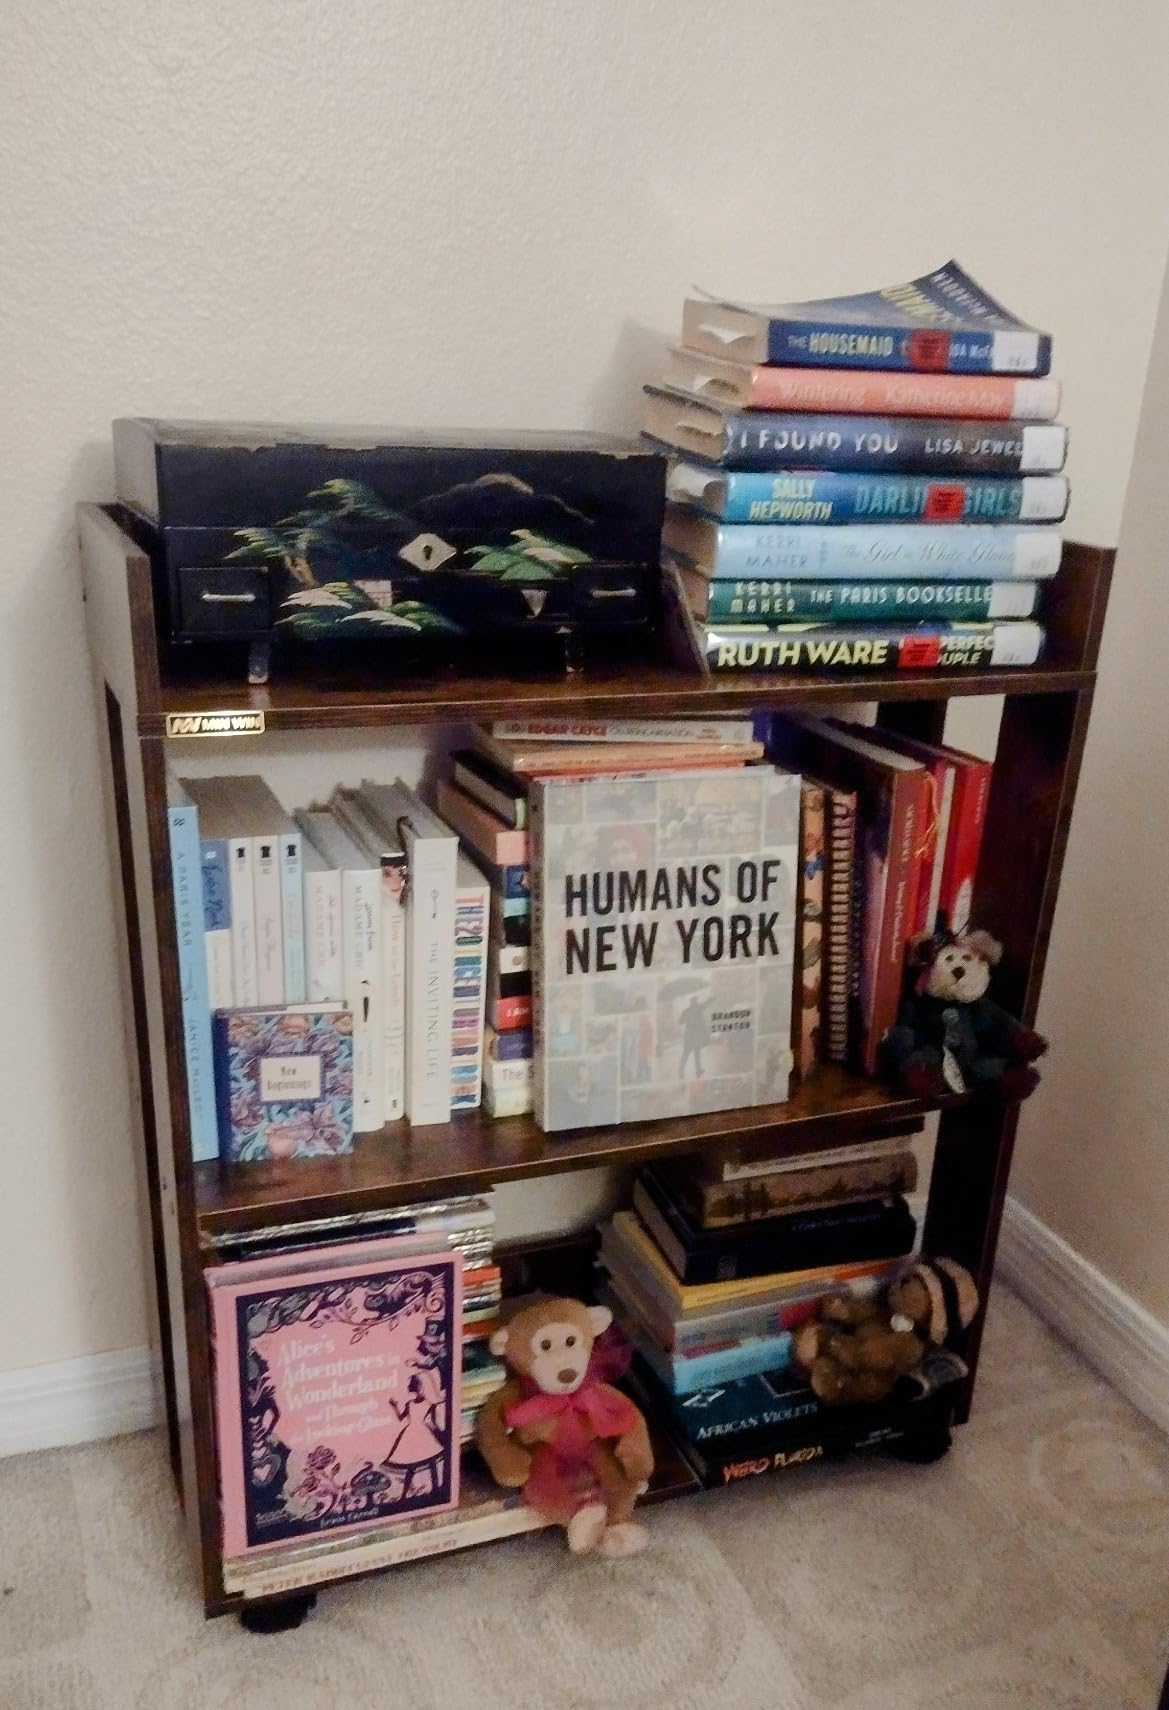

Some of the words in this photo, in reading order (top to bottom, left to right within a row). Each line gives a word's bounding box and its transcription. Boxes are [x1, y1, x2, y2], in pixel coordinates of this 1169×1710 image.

[809, 332, 893, 357] HOUSEMAID
[740, 432, 748, 449] I
[759, 431, 842, 451] FOUND
[854, 433, 899, 453] YOU
[924, 438, 963, 455] LISA
[969, 439, 1023, 457] JEWEL
[771, 478, 815, 499] SALLY
[855, 484, 926, 515] DARLI
[751, 500, 833, 521] HEPWORTH
[746, 554, 808, 569] MAHER
[730, 599, 796, 613] MAHER
[810, 589, 833, 603] THE
[840, 586, 888, 605] PARIS
[896, 586, 993, 604] BOOKSELLE
[718, 641, 809, 667] RUTH
[808, 640, 889, 665] WARE
[940, 635, 994, 650] PERFEC
[179, 866, 189, 907] PARIS
[565, 864, 721, 917] HUMANS
[737, 860, 780, 903] OF
[181, 911, 192, 946] YEAR
[566, 922, 658, 974] NEW
[676, 912, 779, 963] YORK
[426, 970, 440, 1043] INVITING
[425, 1048, 439, 1081] LIFE
[279, 1333, 336, 1367] Alice's
[283, 1355, 385, 1392] Adventures
[284, 1368, 400, 1410] Wonderland
[696, 1416, 759, 1441] AFRICAN
[761, 1401, 819, 1425] VIOLETS
